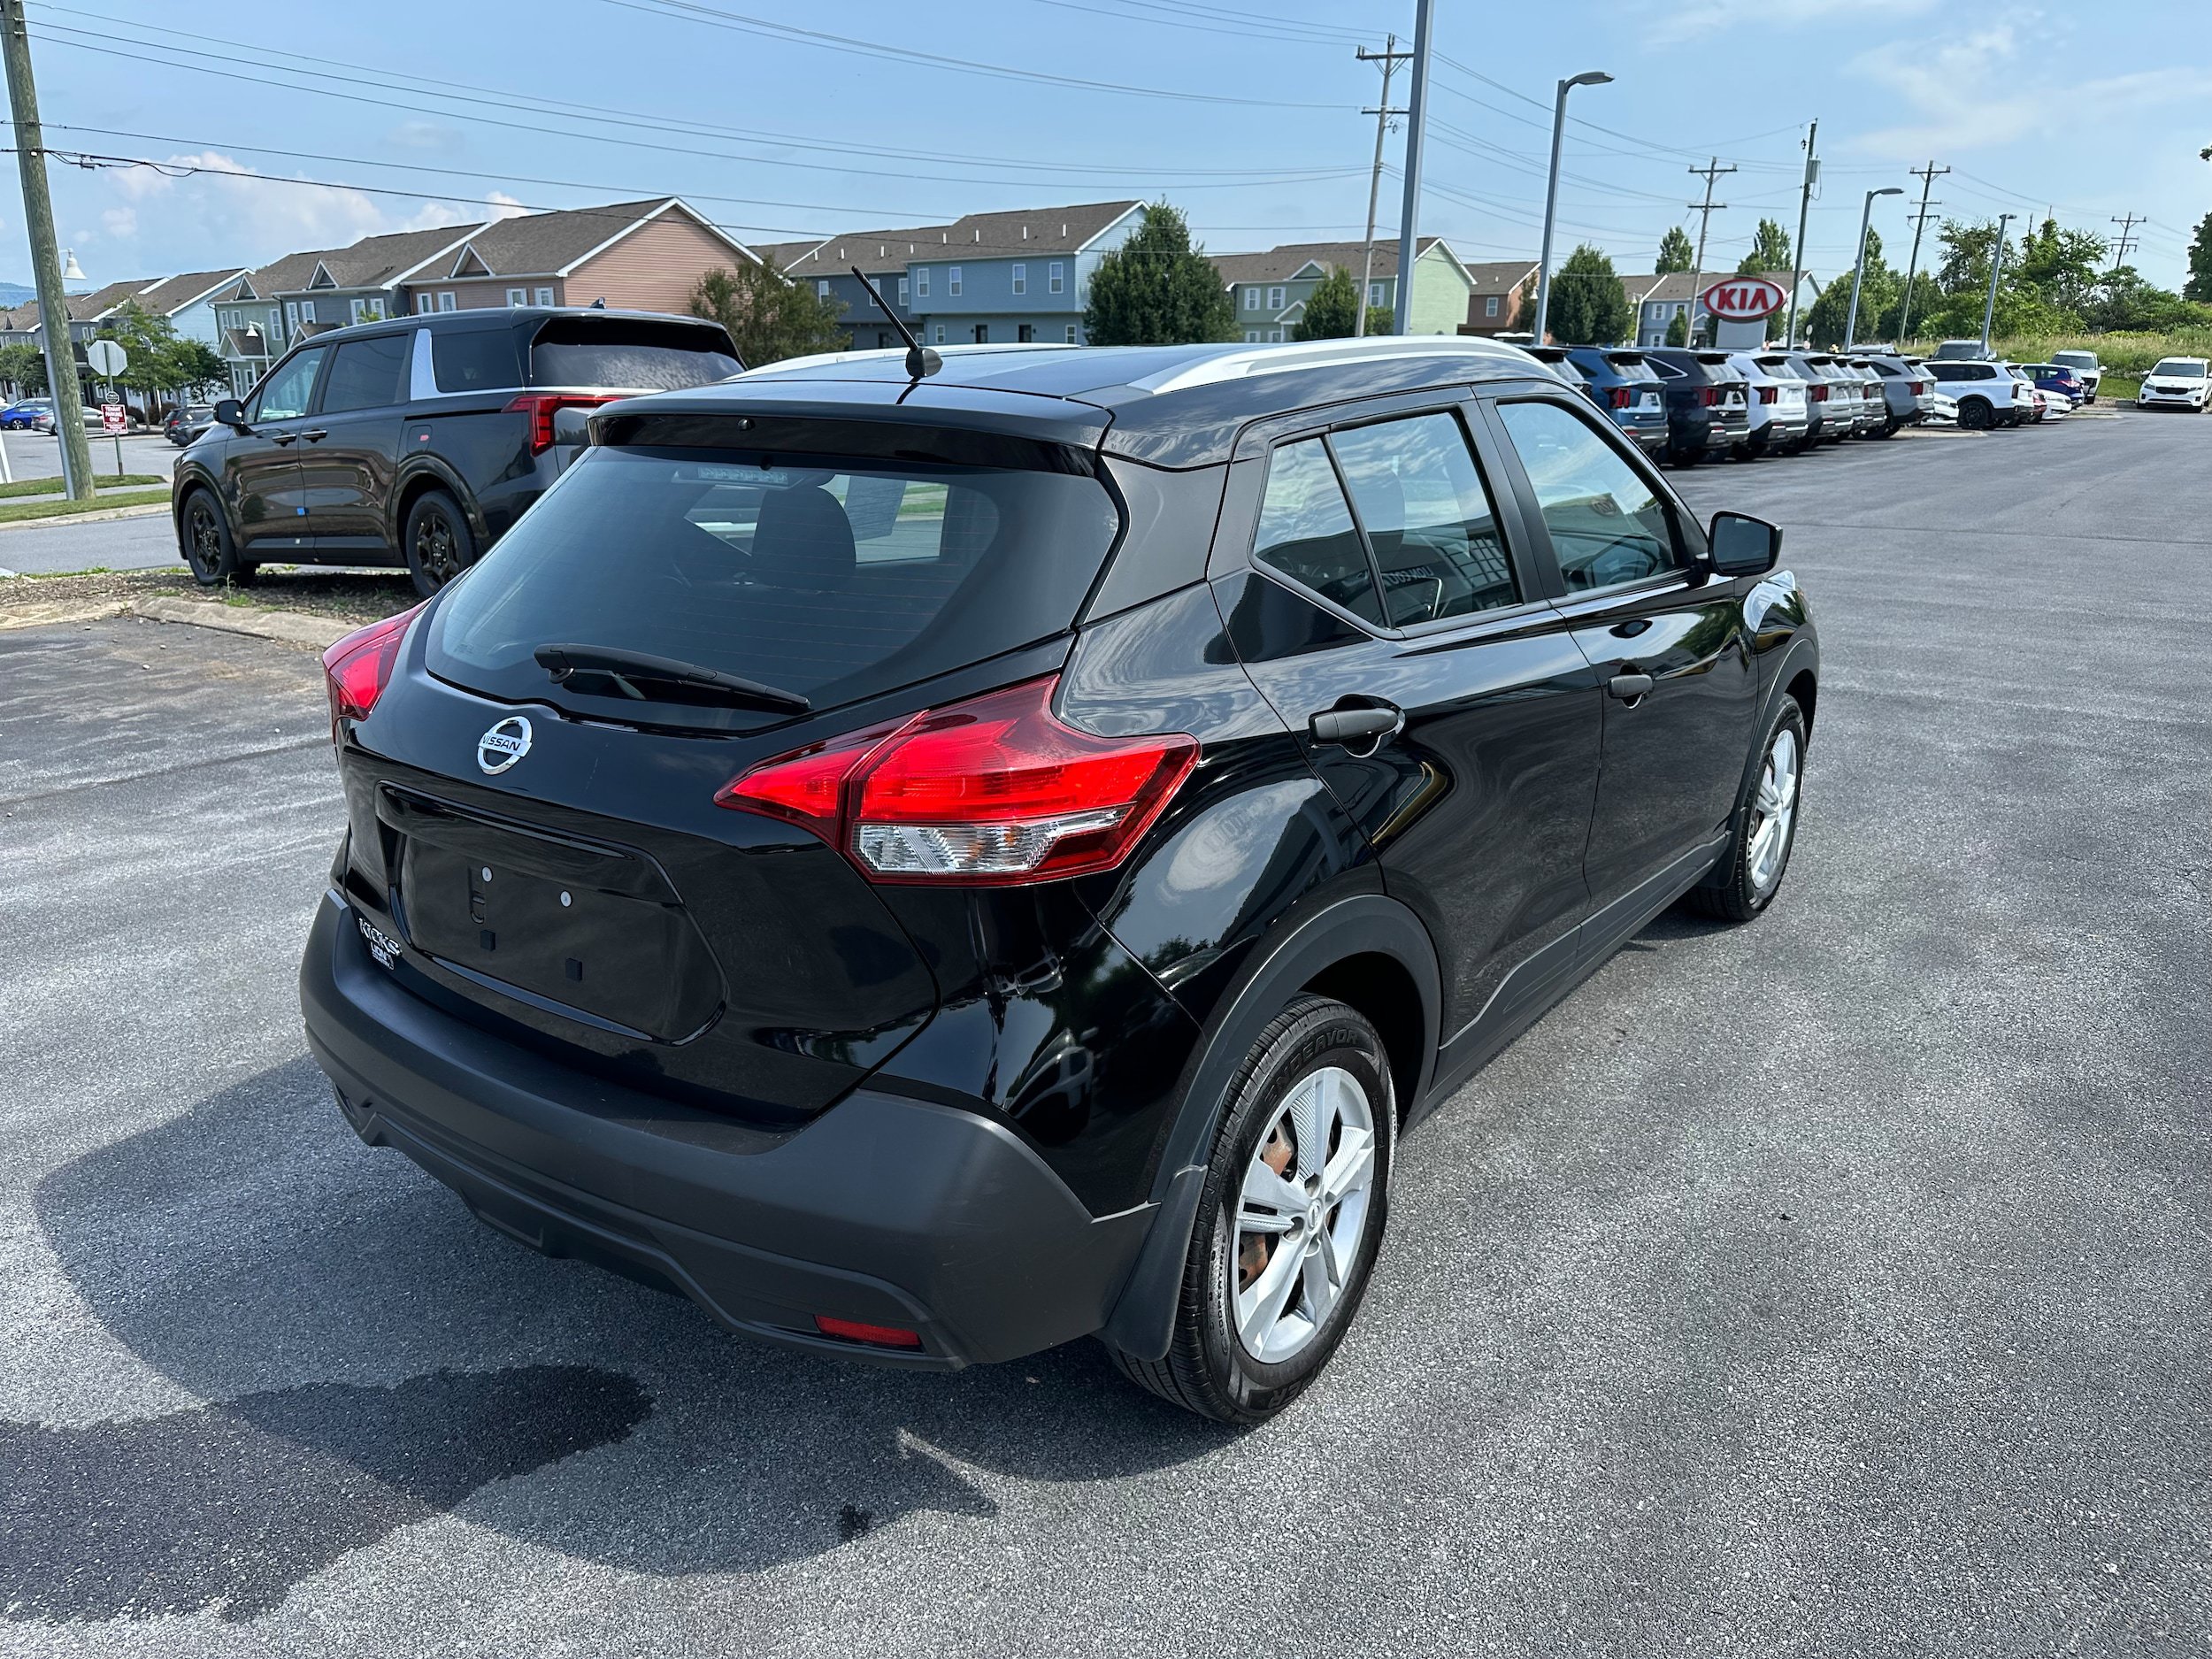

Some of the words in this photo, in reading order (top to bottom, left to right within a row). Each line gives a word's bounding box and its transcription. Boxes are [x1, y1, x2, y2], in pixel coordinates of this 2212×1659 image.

[1717, 288, 1769, 310] KIA
[483, 735, 520, 751] NISSAN
[358, 918, 403, 956] KICKS
[1263, 1027, 1358, 1107] ENDEAVOR
